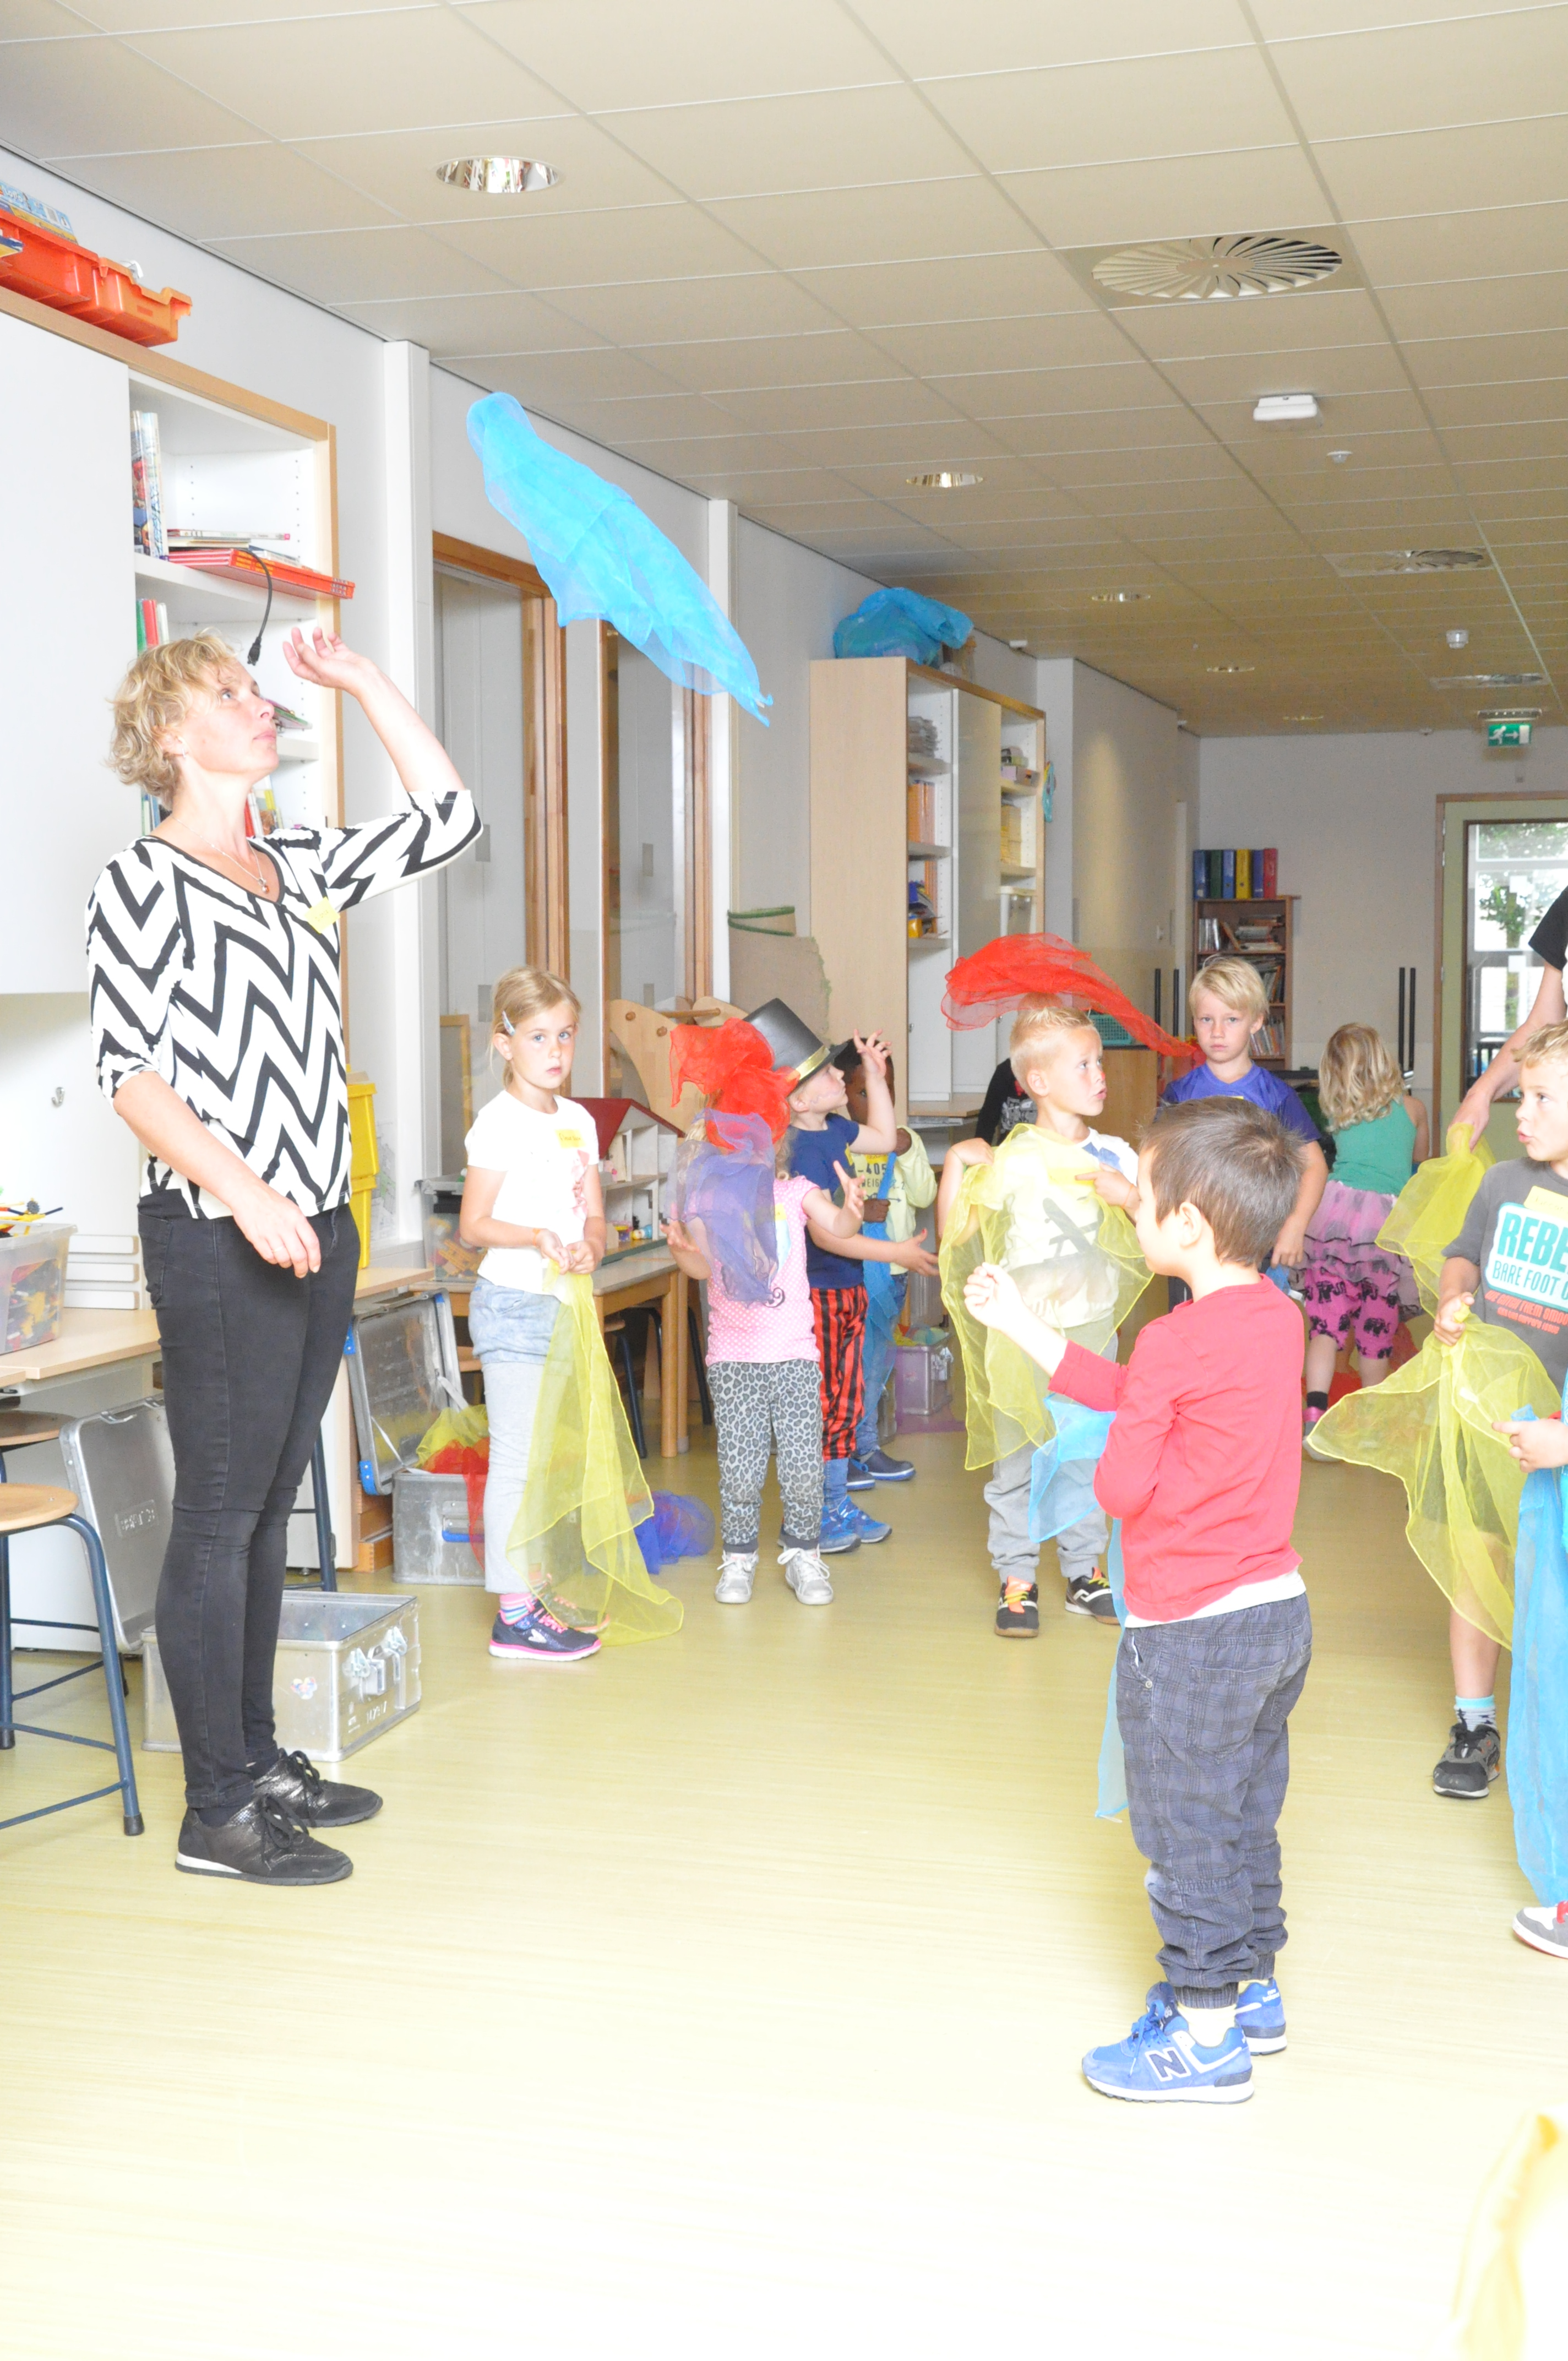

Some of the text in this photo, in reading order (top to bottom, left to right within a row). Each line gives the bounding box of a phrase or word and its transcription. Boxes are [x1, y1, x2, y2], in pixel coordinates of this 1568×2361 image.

[1496, 1211, 1568, 1274] REBE
[1492, 1260, 1522, 1286] BARE
[1523, 1269, 1561, 1296] FOOT
[1518, 1300, 1544, 1318] THEM
[1543, 1307, 1568, 1326] SMOO
[1145, 2047, 1191, 2081] N
